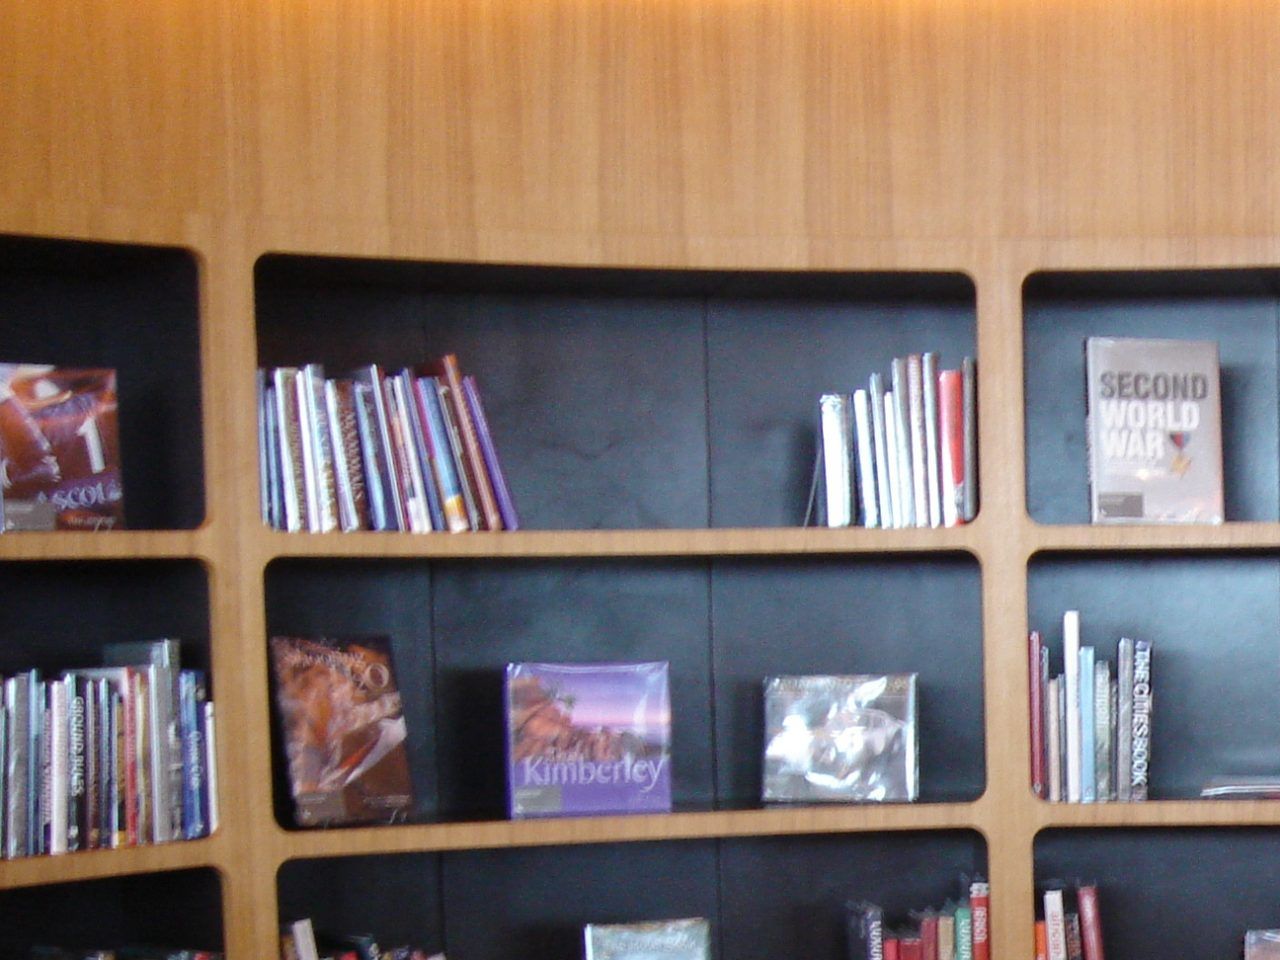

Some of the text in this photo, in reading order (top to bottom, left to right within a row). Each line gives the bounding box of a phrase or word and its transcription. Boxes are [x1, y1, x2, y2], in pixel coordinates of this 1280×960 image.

[1100, 370, 1209, 400] SECOND
[1099, 400, 1201, 430] WORLD
[1101, 428, 1164, 460] WAR
[1131, 648, 1151, 786] THE CITIES BOOK
[524, 752, 665, 793] Kimberley
